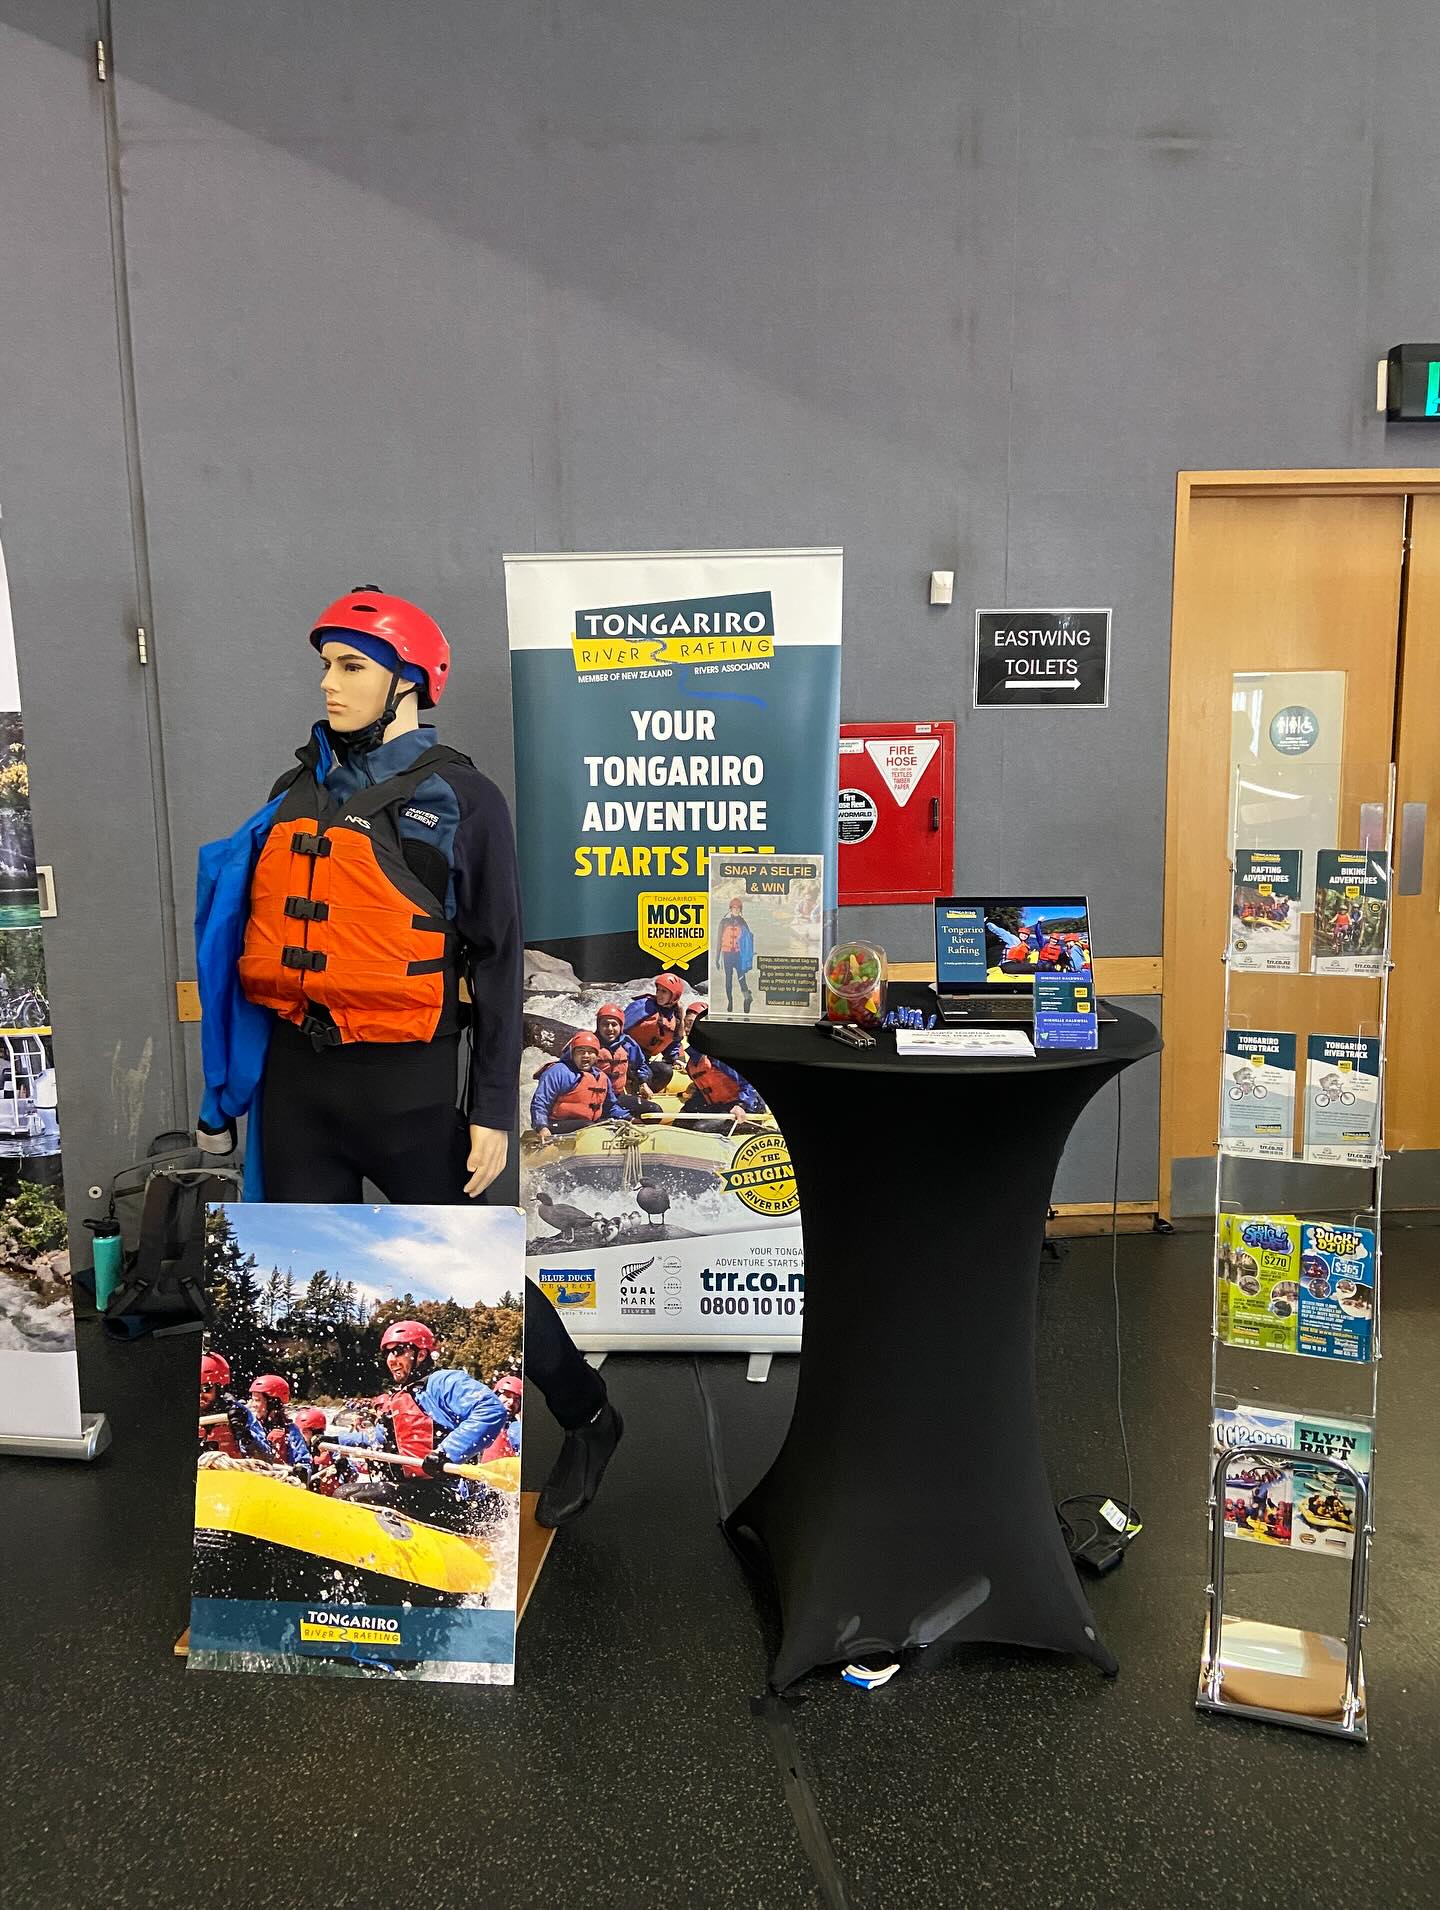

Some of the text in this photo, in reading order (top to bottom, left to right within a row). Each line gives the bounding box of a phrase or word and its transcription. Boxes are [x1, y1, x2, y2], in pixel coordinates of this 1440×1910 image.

[584, 611, 766, 636] TONGARIRO
[994, 630, 1091, 647] EASTWING
[582, 639, 770, 664] RIVER RAFTING
[578, 662, 770, 684] MEMBER OF NEW ZEALAND RIVERS ASSOCIATION
[1005, 659, 1078, 675] TOILETS
[630, 710, 716, 741] YOUR
[889, 746, 915, 755] FIRE
[886, 756, 918, 767] HOSE
[583, 755, 764, 787] TONGARIRO
[344, 814, 371, 830] NRS
[404, 811, 437, 828] ELEMENT
[408, 807, 440, 823] HUNTERS
[581, 801, 767, 832] ADVENTURE
[574, 846, 689, 877] STARTS
[724, 865, 812, 877] SNAP A SELFIE
[1251, 866, 1282, 874] RAFTING
[1341, 867, 1366, 876] BIKING
[1242, 874, 1289, 883] ADVENTURES
[1329, 876, 1378, 885] ADVENTURES
[750, 882, 785, 893] & WIN
[648, 904, 705, 925] MOST
[648, 927, 705, 939] EXPERIENCED
[941, 925, 984, 936] Tongariro
[951, 935, 975, 944] River
[947, 945, 980, 957] Rafting
[1239, 1036, 1279, 1045] TONGARIRO
[1325, 1041, 1368, 1051] TONGARIRO
[1237, 1043, 1280, 1053] RIVER TRACK
[1324, 1049, 1345, 1058] RIVER
[741, 1138, 787, 1162] TONGARI
[760, 1153, 781, 1163] THE
[730, 1164, 796, 1187] ORIGIN
[744, 1190, 800, 1210] RIVER RAFT
[1315, 1227, 1353, 1245] DUCK
[749, 1247, 804, 1256] YOUR TONGA
[715, 1258, 799, 1268] ADVENTURE STARTS
[1264, 1255, 1287, 1268] $270
[1335, 1261, 1359, 1275] $365
[541, 1274, 592, 1282] BLUE DUCK
[700, 1268, 805, 1292] trr.co.n
[620, 1286, 656, 1296] QUAL
[620, 1297, 656, 1305] MARK
[700, 1297, 749, 1316] 0800
[752, 1297, 773, 1316] 10
[776, 1297, 796, 1316] 10
[1300, 1429, 1357, 1449] FLY'N
[1300, 1441, 1351, 1461] RAFT
[307, 1610, 399, 1631] TONGARIRO
[304, 1628, 399, 1642] RIVER RAFTING
